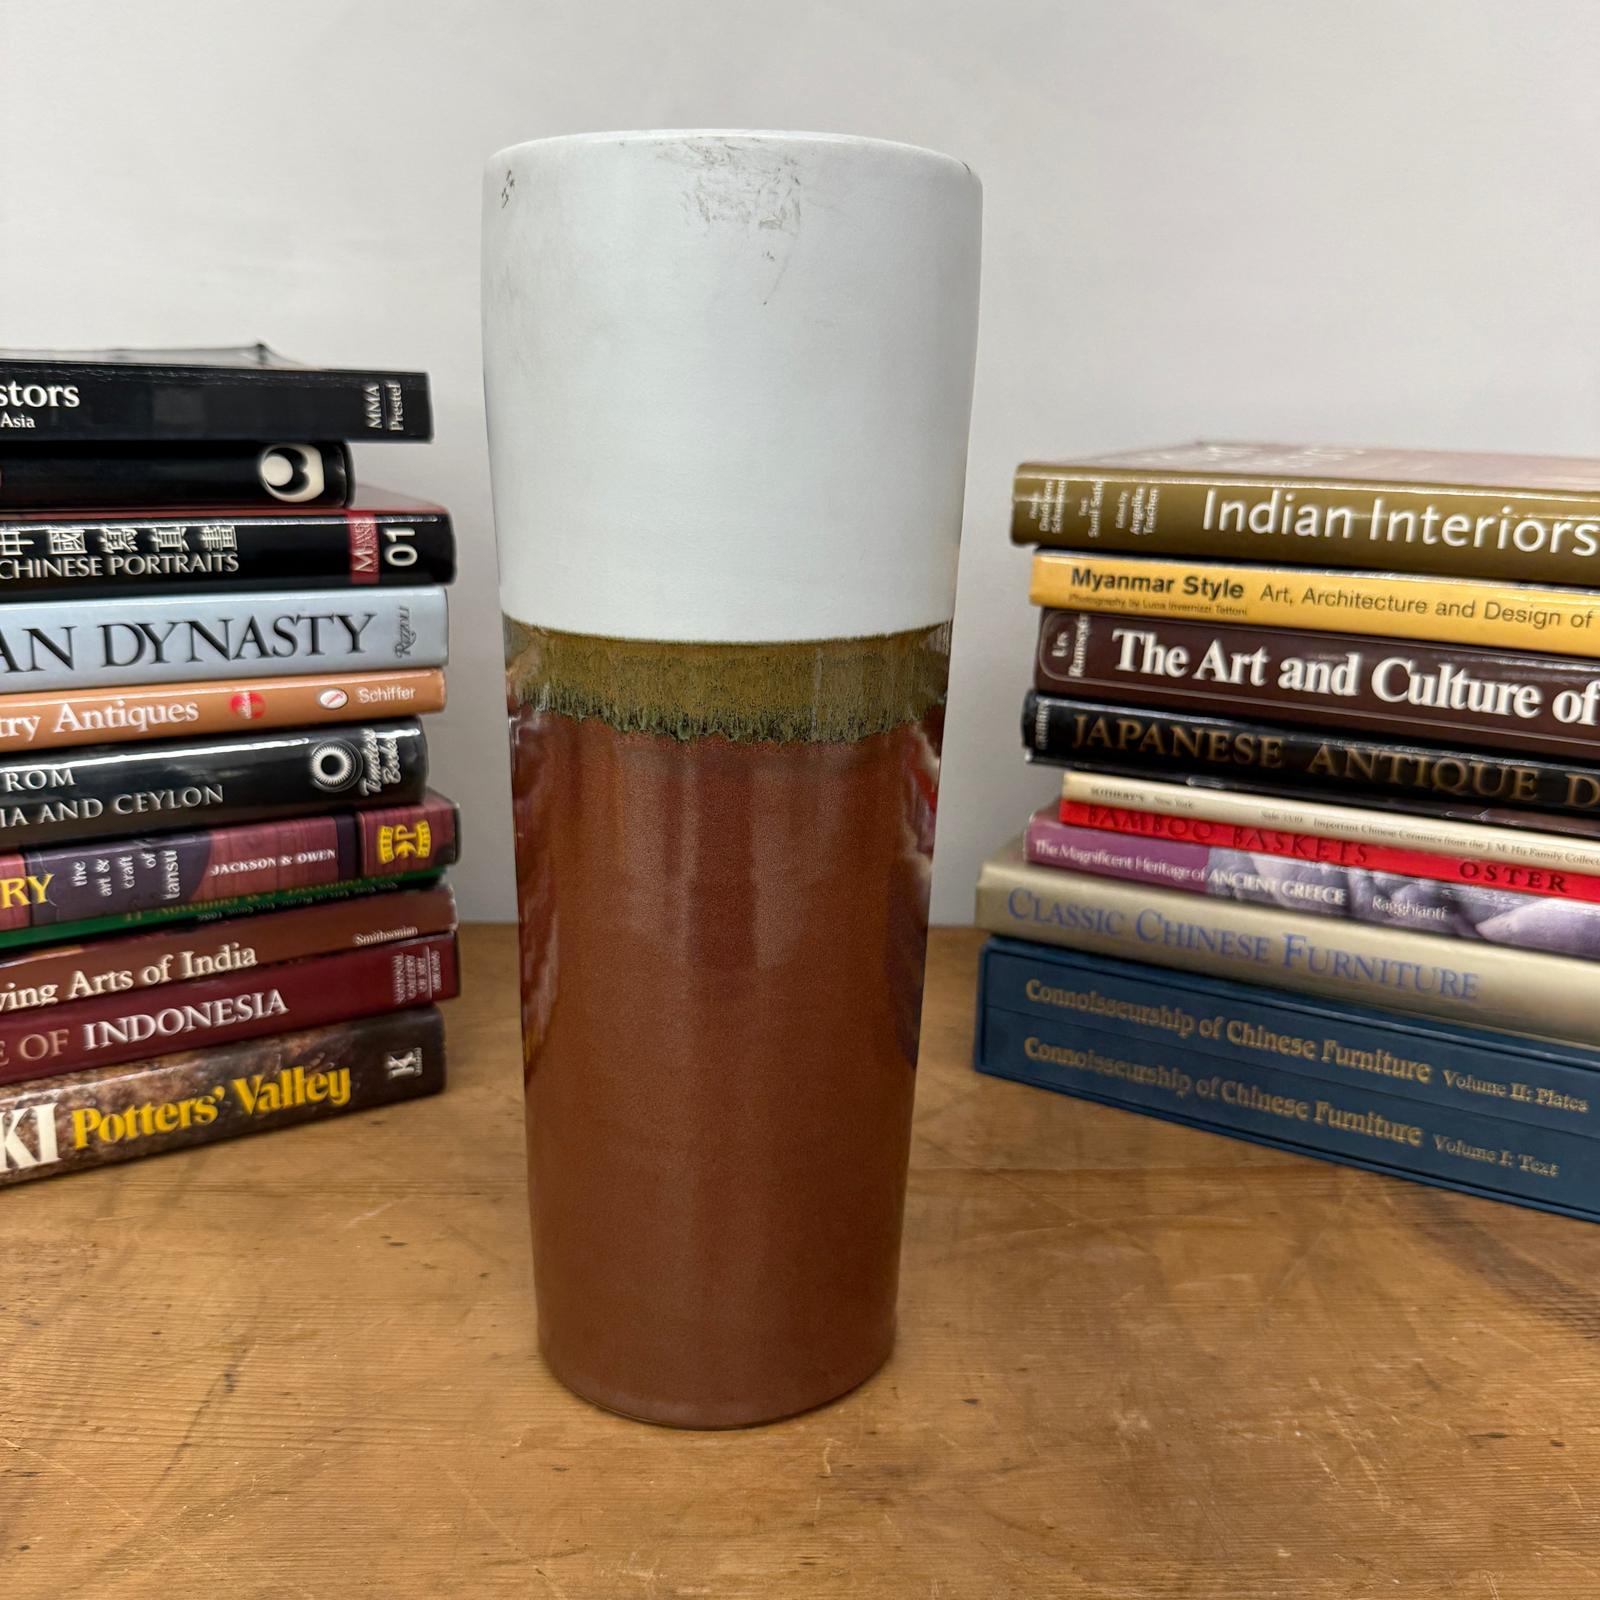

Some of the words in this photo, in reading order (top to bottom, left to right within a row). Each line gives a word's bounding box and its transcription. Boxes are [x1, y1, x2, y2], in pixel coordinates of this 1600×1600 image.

[0, 411, 36, 428] Asia
[365, 384, 383, 430] MMA
[386, 382, 405, 432] Prestel
[1202, 487, 1352, 539] Indian
[1369, 496, 1600, 557] Interiors
[0, 556, 103, 580] CHINESE
[109, 551, 240, 577] PORTRAITS
[383, 527, 418, 567] 01
[1070, 567, 1175, 595] Myanmar
[1183, 575, 1245, 601] Style
[1260, 583, 1293, 607] Art,
[1302, 587, 1428, 615] Architecture
[1435, 600, 1475, 618] and
[1484, 601, 1561, 630] Design
[1570, 610, 1593, 629] of
[97, 612, 377, 669] DYNASTY
[357, 685, 417, 704] Schiffer
[1111, 627, 1190, 679] The
[1193, 639, 1270, 688] Art
[1277, 650, 1363, 697] and
[1371, 655, 1544, 720] Culture
[1552, 679, 1600, 727] of
[52, 701, 200, 736] Antiques
[1072, 713, 1285, 769] JAPANESE
[1306, 744, 1541, 801] ANTIQUE
[5, 768, 76, 792] ROM
[39, 797, 104, 823] AND
[112, 784, 225, 817] CEYLON
[1087, 804, 1214, 841] BAMBOO
[1232, 825, 1368, 865] BASKETS
[1361, 824, 1397, 838] Chinese
[1468, 837, 1485, 850] the
[1529, 847, 1562, 861] Family
[72, 861, 88, 887] the
[95, 858, 110, 874] &
[118, 856, 136, 890] craft
[140, 852, 157, 869] of
[162, 850, 181, 900] tansu
[210, 856, 277, 878] JACKSON
[281, 854, 294, 868] &
[296, 848, 337, 865] OWEN
[1035, 839, 1059, 856] The
[1058, 844, 1133, 871] Magnificent
[1135, 855, 1192, 884] Heritage
[1191, 867, 1206, 882] of
[1208, 867, 1278, 893] ANCIENT
[1281, 880, 1347, 906] GREECE
[1371, 895, 1448, 922] Ragghianti
[1458, 860, 1570, 894] OSTER
[0, 872, 55, 909] RY
[96, 877, 113, 897] art
[352, 925, 418, 946] Smithsonian
[1007, 886, 1127, 937] CLASSIC
[1135, 907, 1271, 962] CHINESE
[1283, 932, 1481, 1000] FURNITURE
[68, 966, 134, 1000] Arts
[142, 955, 173, 984] of
[181, 942, 259, 979] India
[19, 1028, 70, 1062] OF
[82, 988, 290, 1052] INDONESIA
[1025, 978, 1194, 1040] Connoisseurship
[1199, 1016, 1225, 1040] of
[1227, 1020, 1317, 1061] Chinese
[1321, 1039, 1433, 1085] Furniture
[1443, 1069, 1507, 1098] Volume
[1535, 1087, 1590, 1114] Plates
[233, 1065, 353, 1116] Valley
[1023, 1036, 1192, 1099] Connoisseurship
[1196, 1077, 1221, 1099] of
[1221, 1080, 1311, 1123] Chinese
[1313, 1100, 1424, 1148] Furniture
[1433, 1133, 1496, 1164] Volume
[1518, 1153, 1560, 1179] Text
